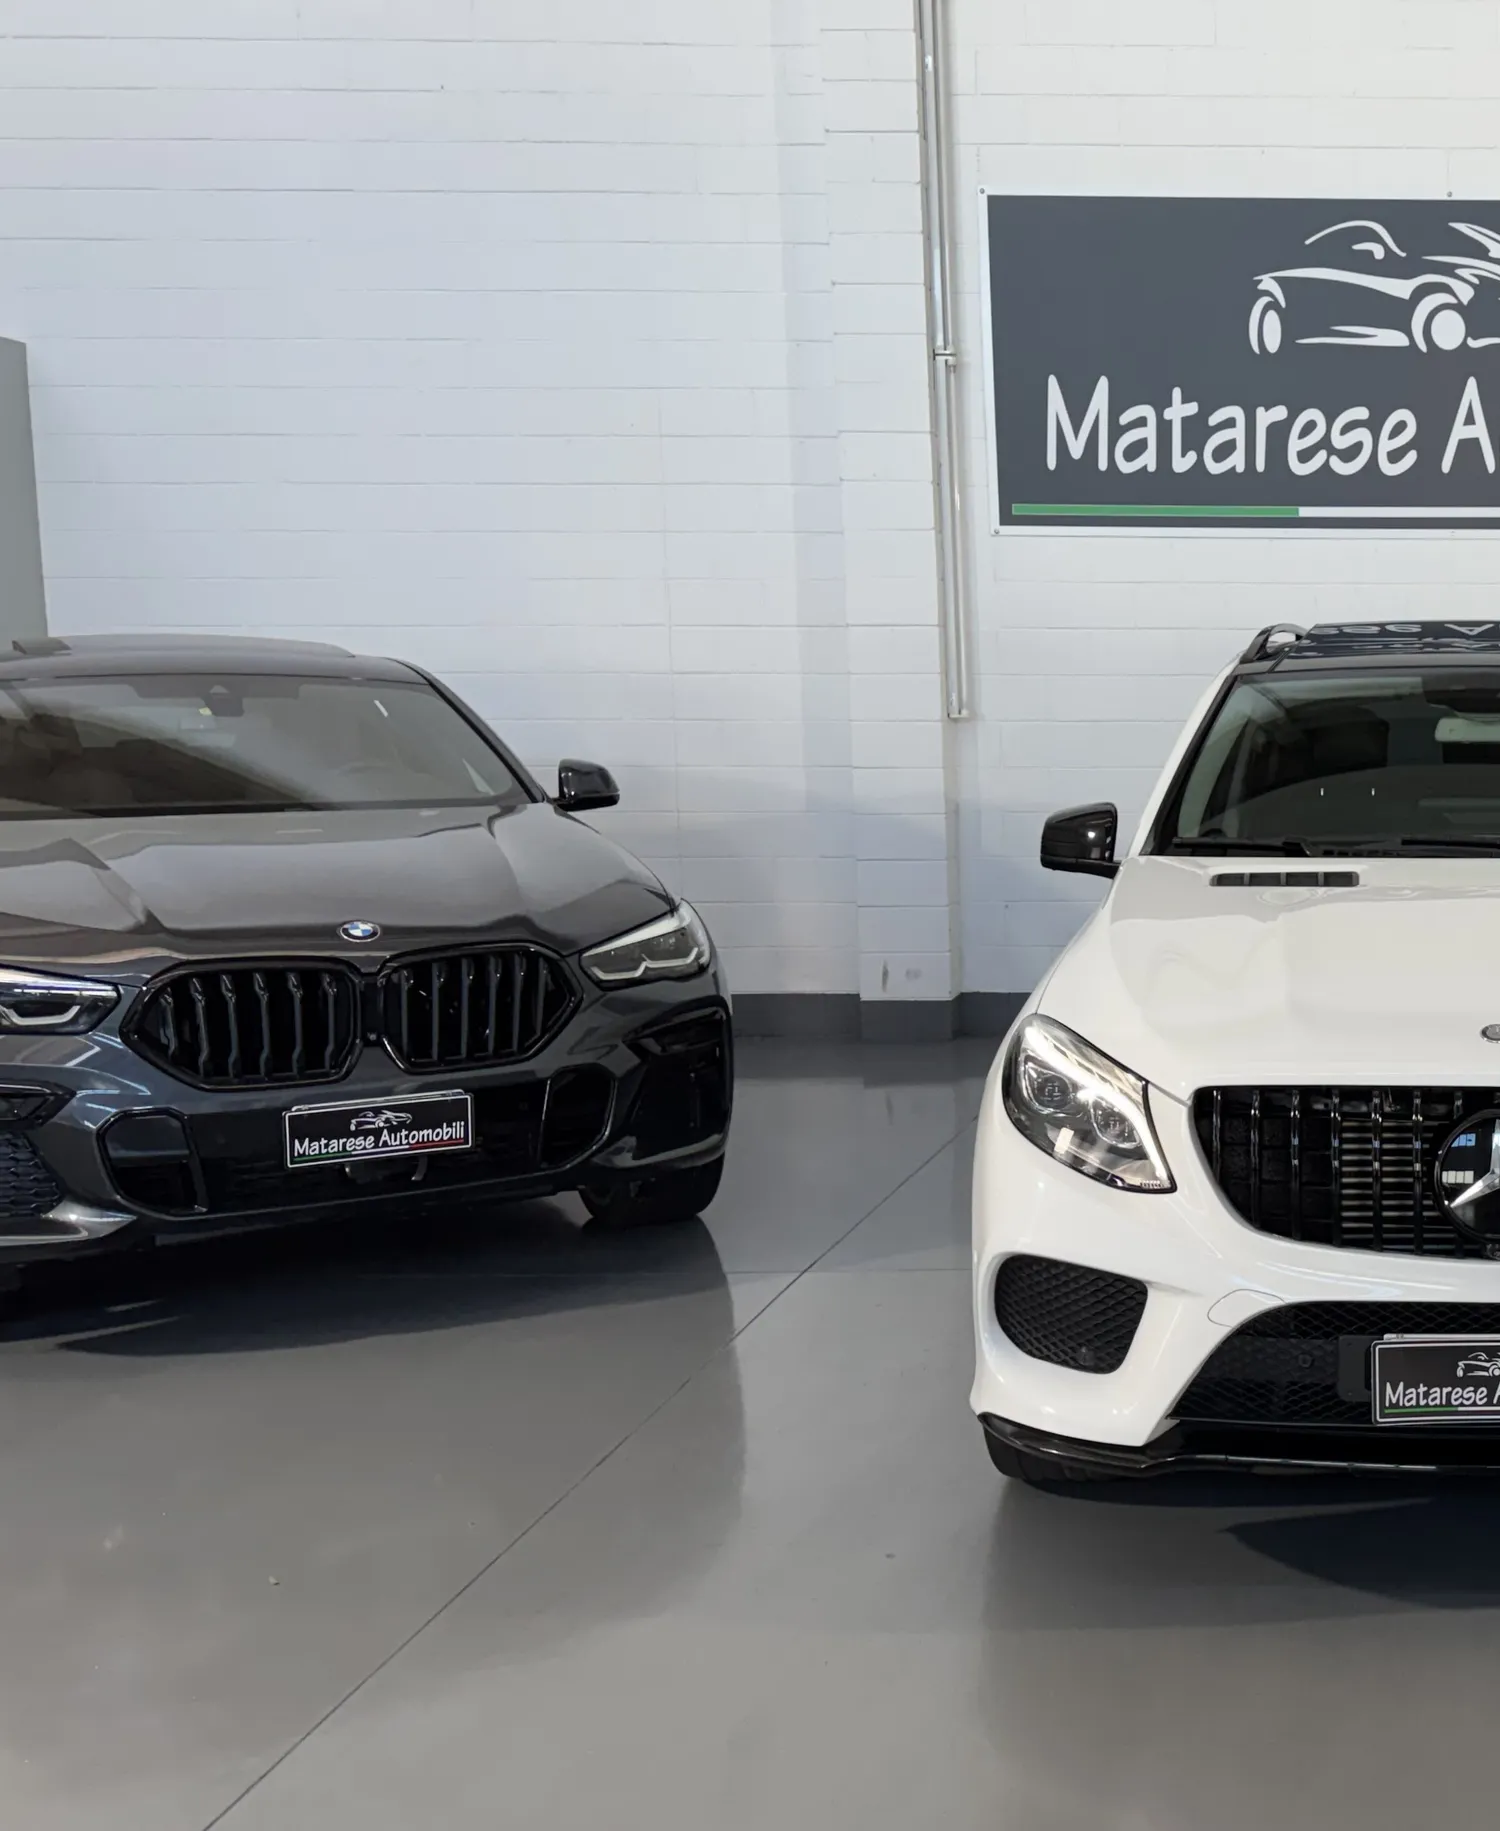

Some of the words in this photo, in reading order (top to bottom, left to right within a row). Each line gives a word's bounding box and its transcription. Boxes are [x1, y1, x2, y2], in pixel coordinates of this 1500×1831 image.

[1046, 374, 1418, 477] Matarese
[294, 1134, 375, 1157] Matarese
[378, 1120, 465, 1147] Automobili
[1385, 1380, 1488, 1407] Matarese
